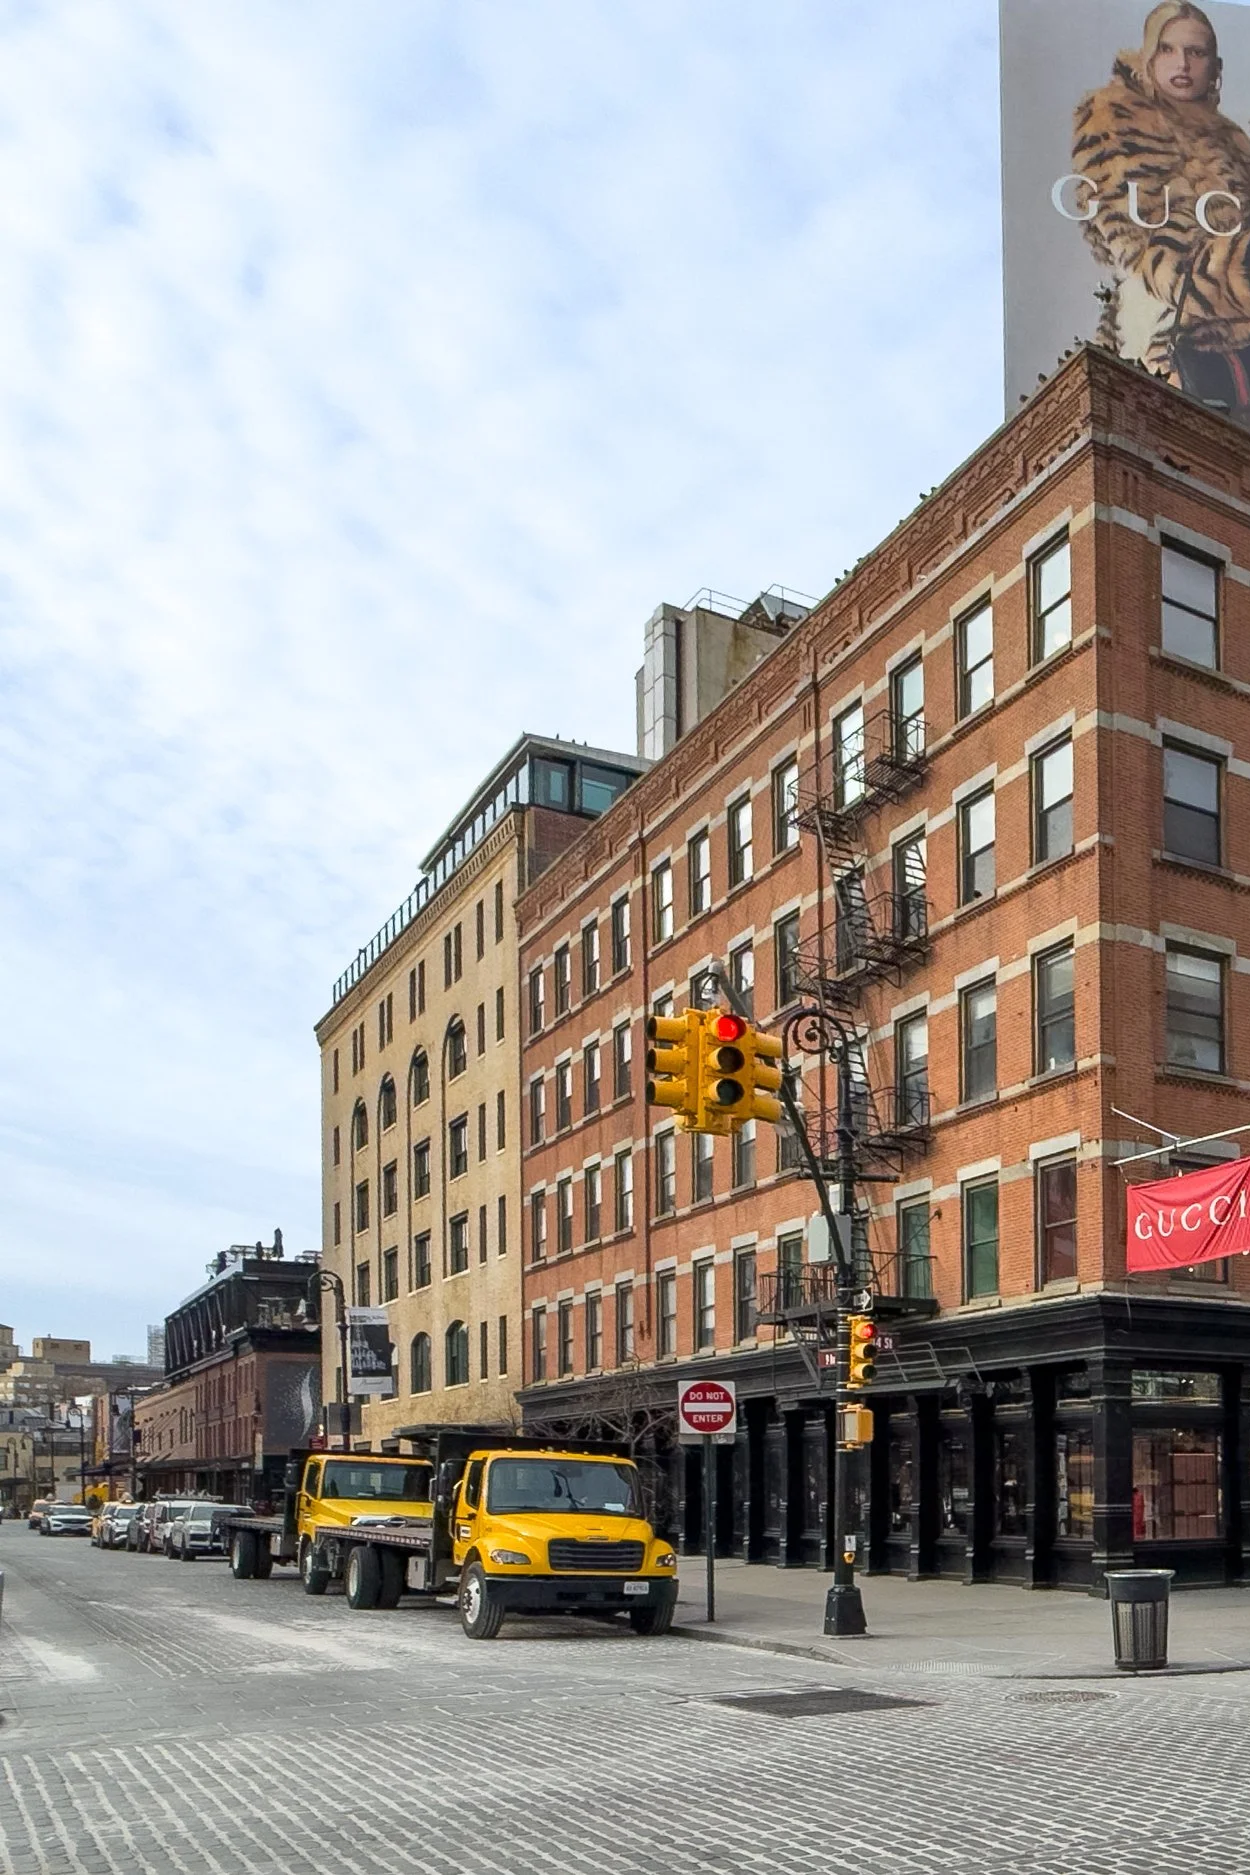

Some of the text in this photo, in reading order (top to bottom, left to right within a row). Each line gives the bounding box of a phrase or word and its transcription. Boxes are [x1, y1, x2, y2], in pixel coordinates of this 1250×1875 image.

[1135, 1189, 1247, 1240] GUCCI
[884, 1337, 893, 1349] St
[689, 1391, 725, 1401] DO NOT
[692, 1414, 724, 1423] ENTER
